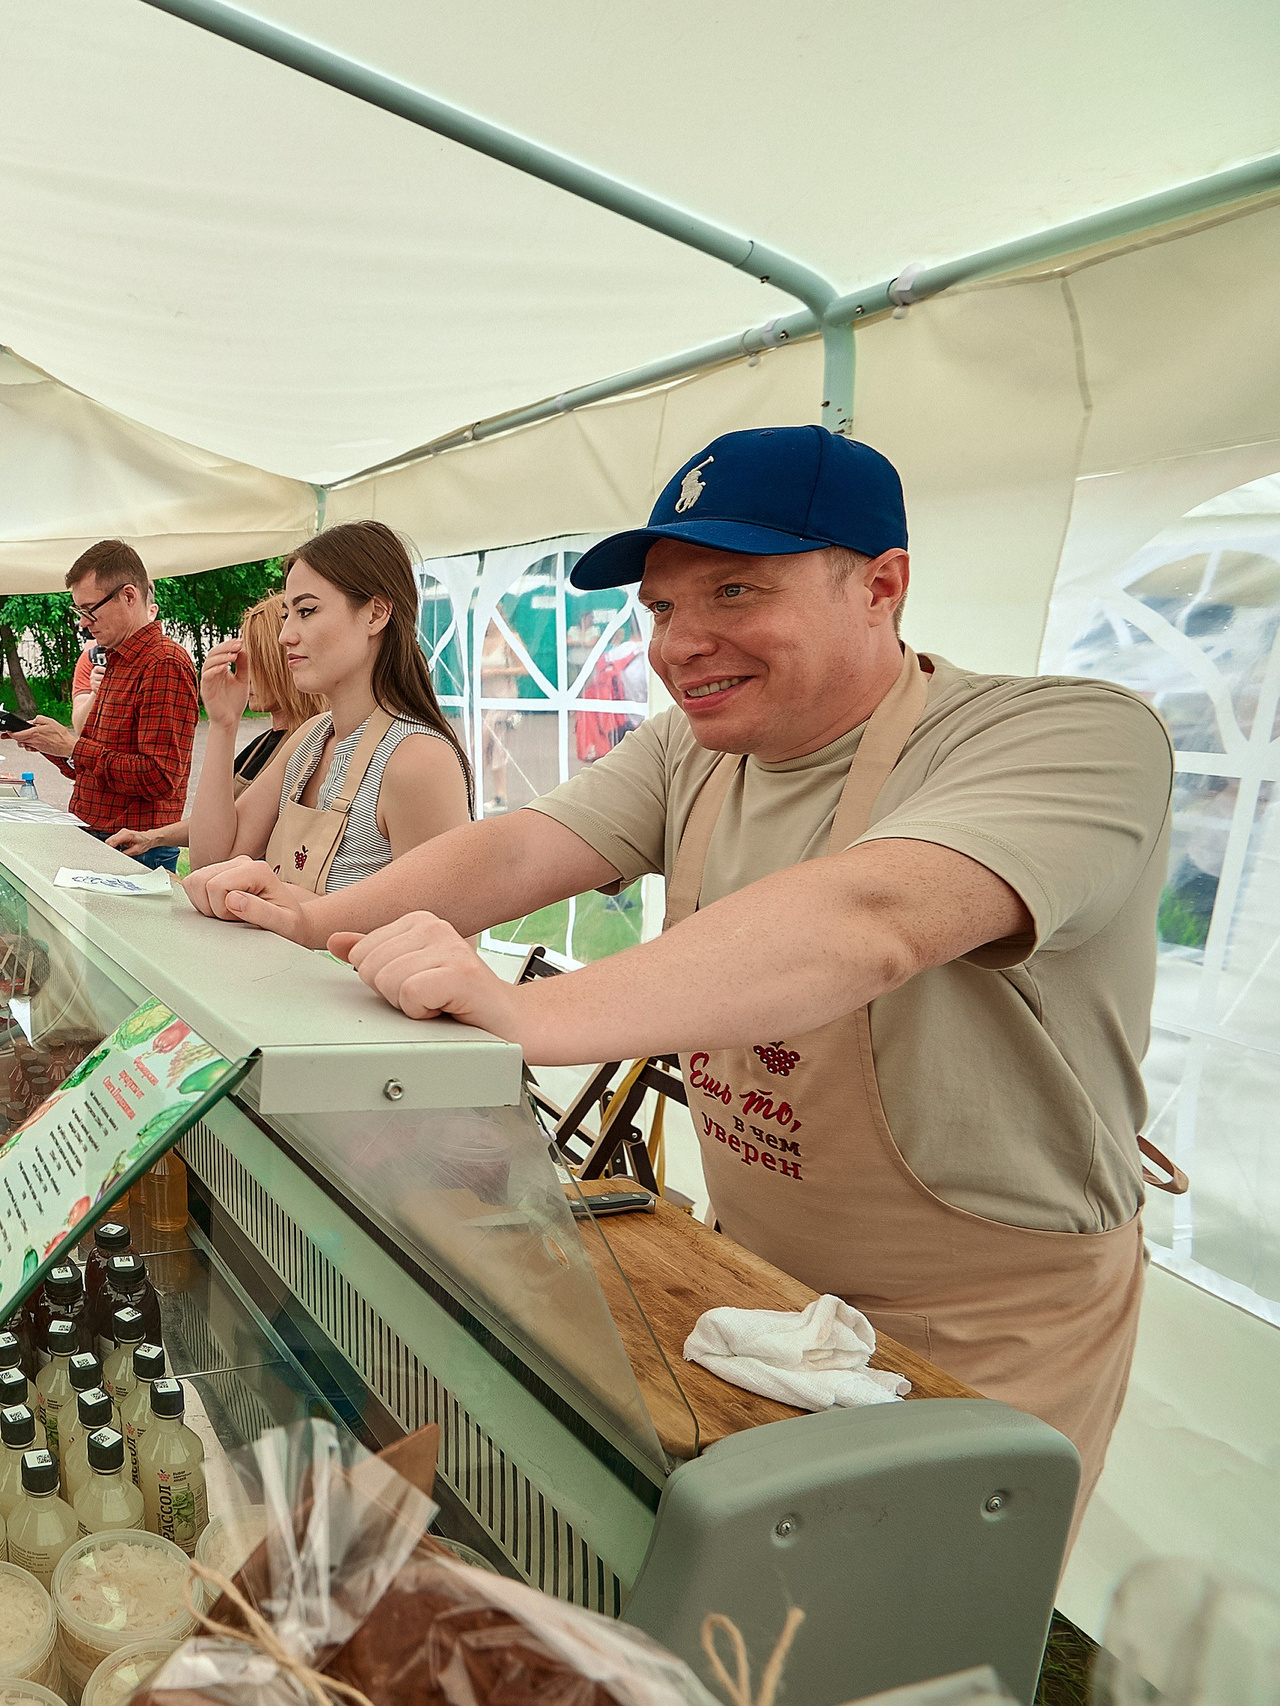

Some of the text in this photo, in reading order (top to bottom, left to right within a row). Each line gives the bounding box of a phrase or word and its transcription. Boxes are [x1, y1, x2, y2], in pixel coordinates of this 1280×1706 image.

[689, 1052, 732, 1105] Ешь
[701, 1111, 803, 1181] уверен
[732, 1115, 802, 1157] в чем
[158, 1484, 175, 1542] РАССОЛ
